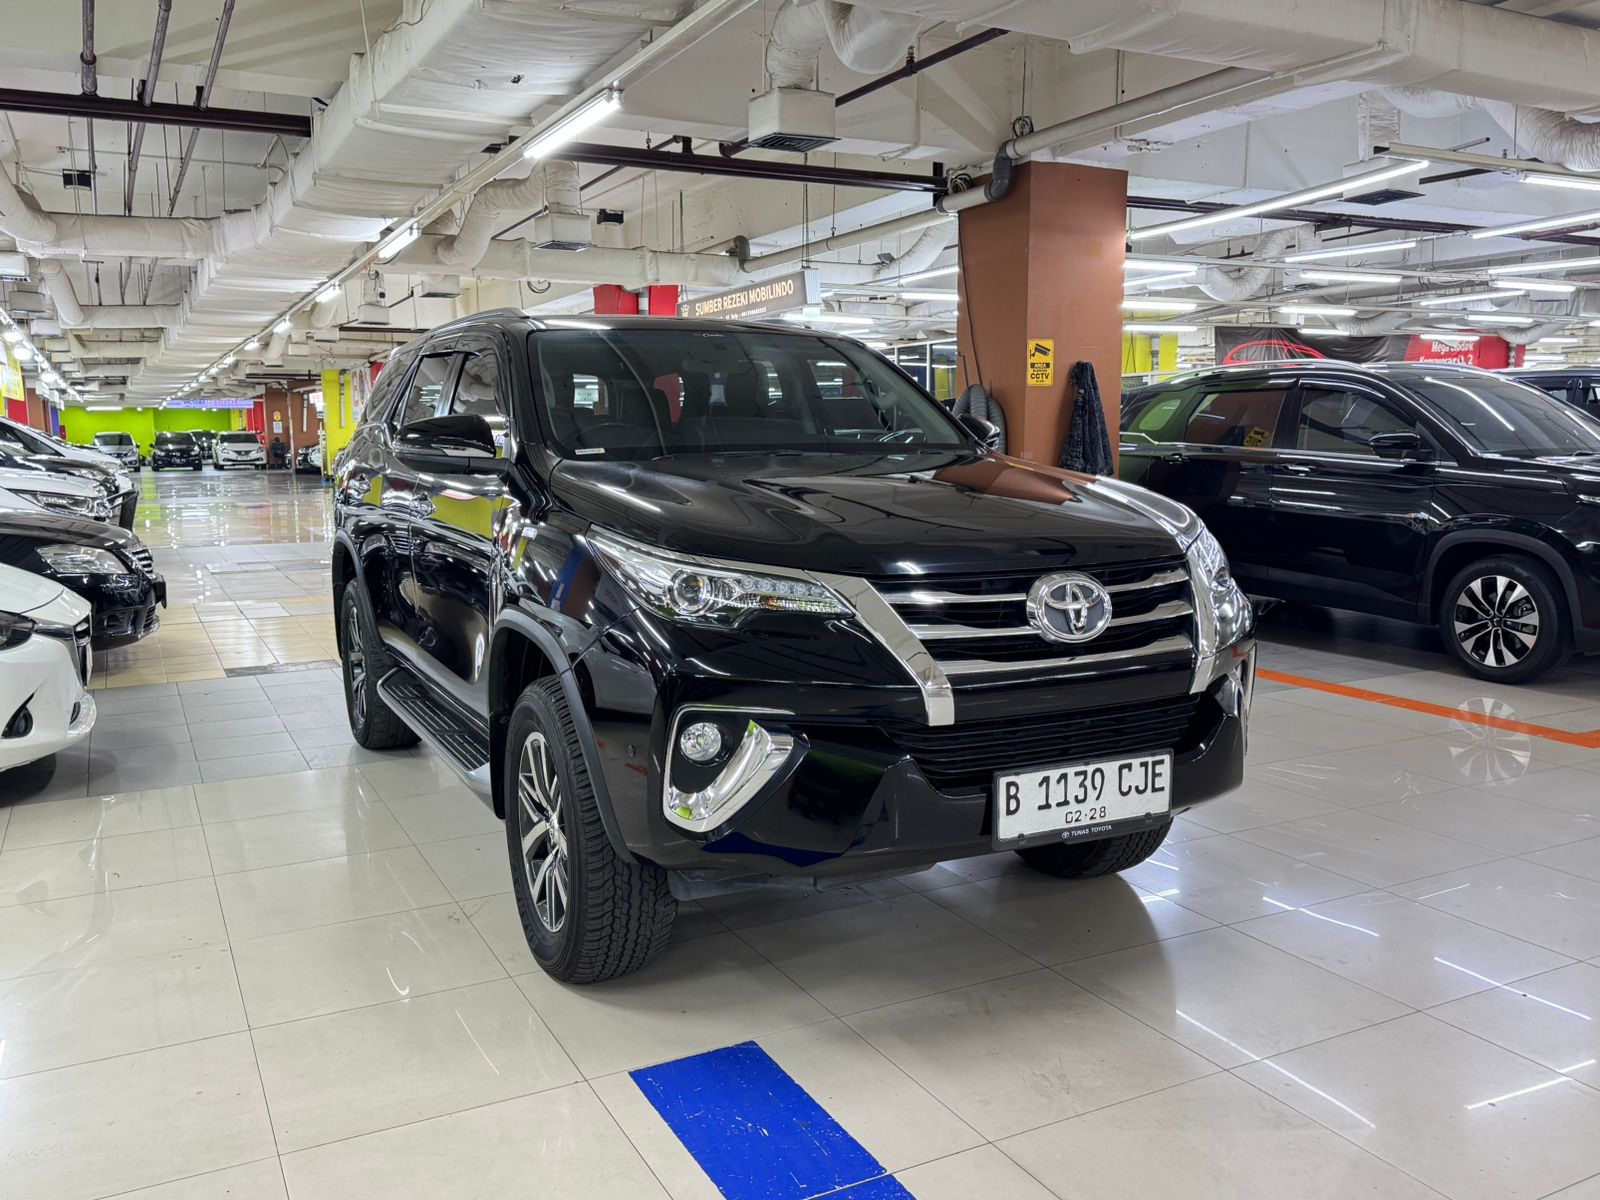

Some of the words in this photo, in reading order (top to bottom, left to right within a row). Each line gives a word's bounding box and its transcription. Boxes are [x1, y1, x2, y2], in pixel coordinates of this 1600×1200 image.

[695, 297, 722, 317] SUMBER
[722, 291, 748, 310] REZEKI
[749, 280, 794, 304] MOBILINDO
[1431, 341, 1450, 354] Mega
[1005, 780, 1021, 817] B
[1037, 767, 1106, 811] 1139
[1118, 758, 1165, 797] CJE
[1071, 828, 1090, 837] TUNAS
[1091, 824, 1113, 833] TOYOTA
